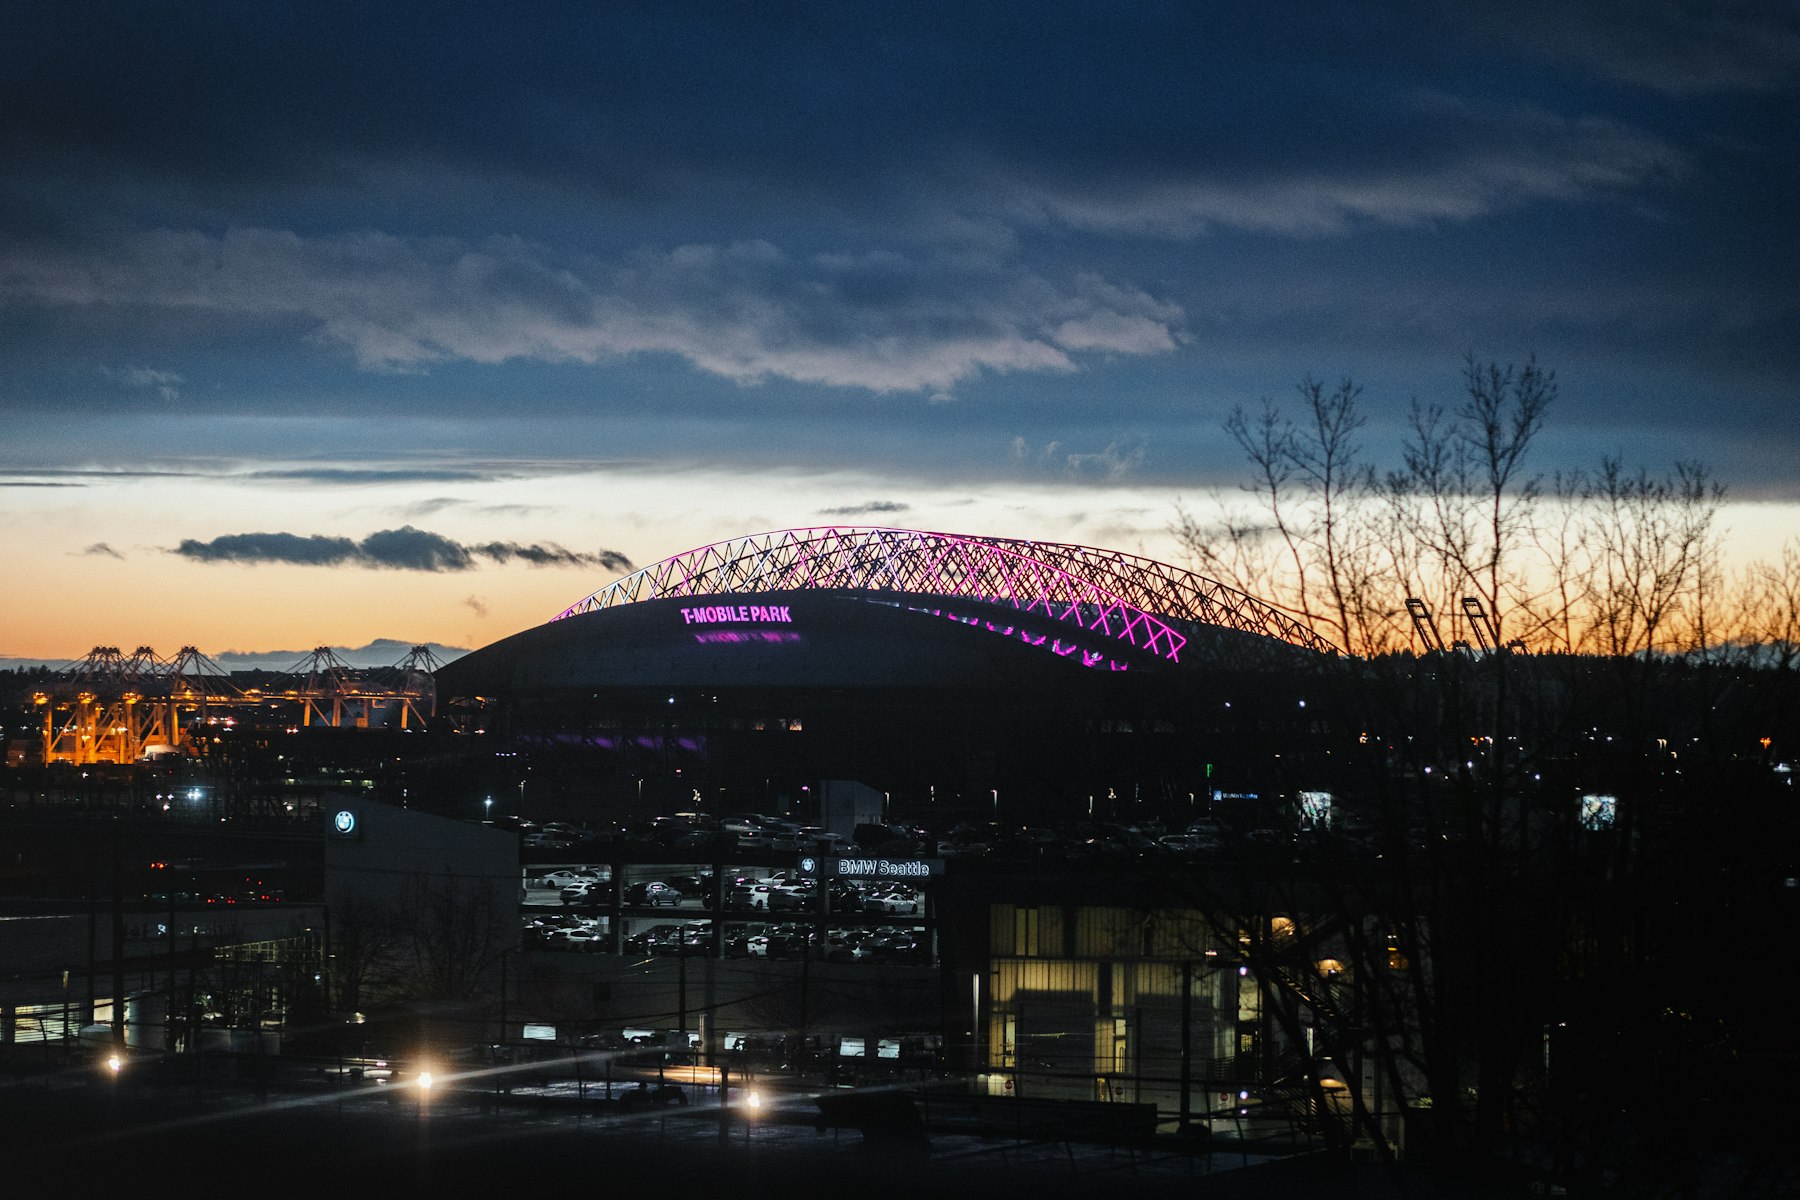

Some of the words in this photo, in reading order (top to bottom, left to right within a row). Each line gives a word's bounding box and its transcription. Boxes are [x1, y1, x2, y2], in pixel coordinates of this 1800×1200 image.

[680, 606, 750, 624] T-MOBILE
[750, 606, 792, 623] PARK
[838, 859, 877, 875] BMW
[878, 860, 930, 876] Seattle
